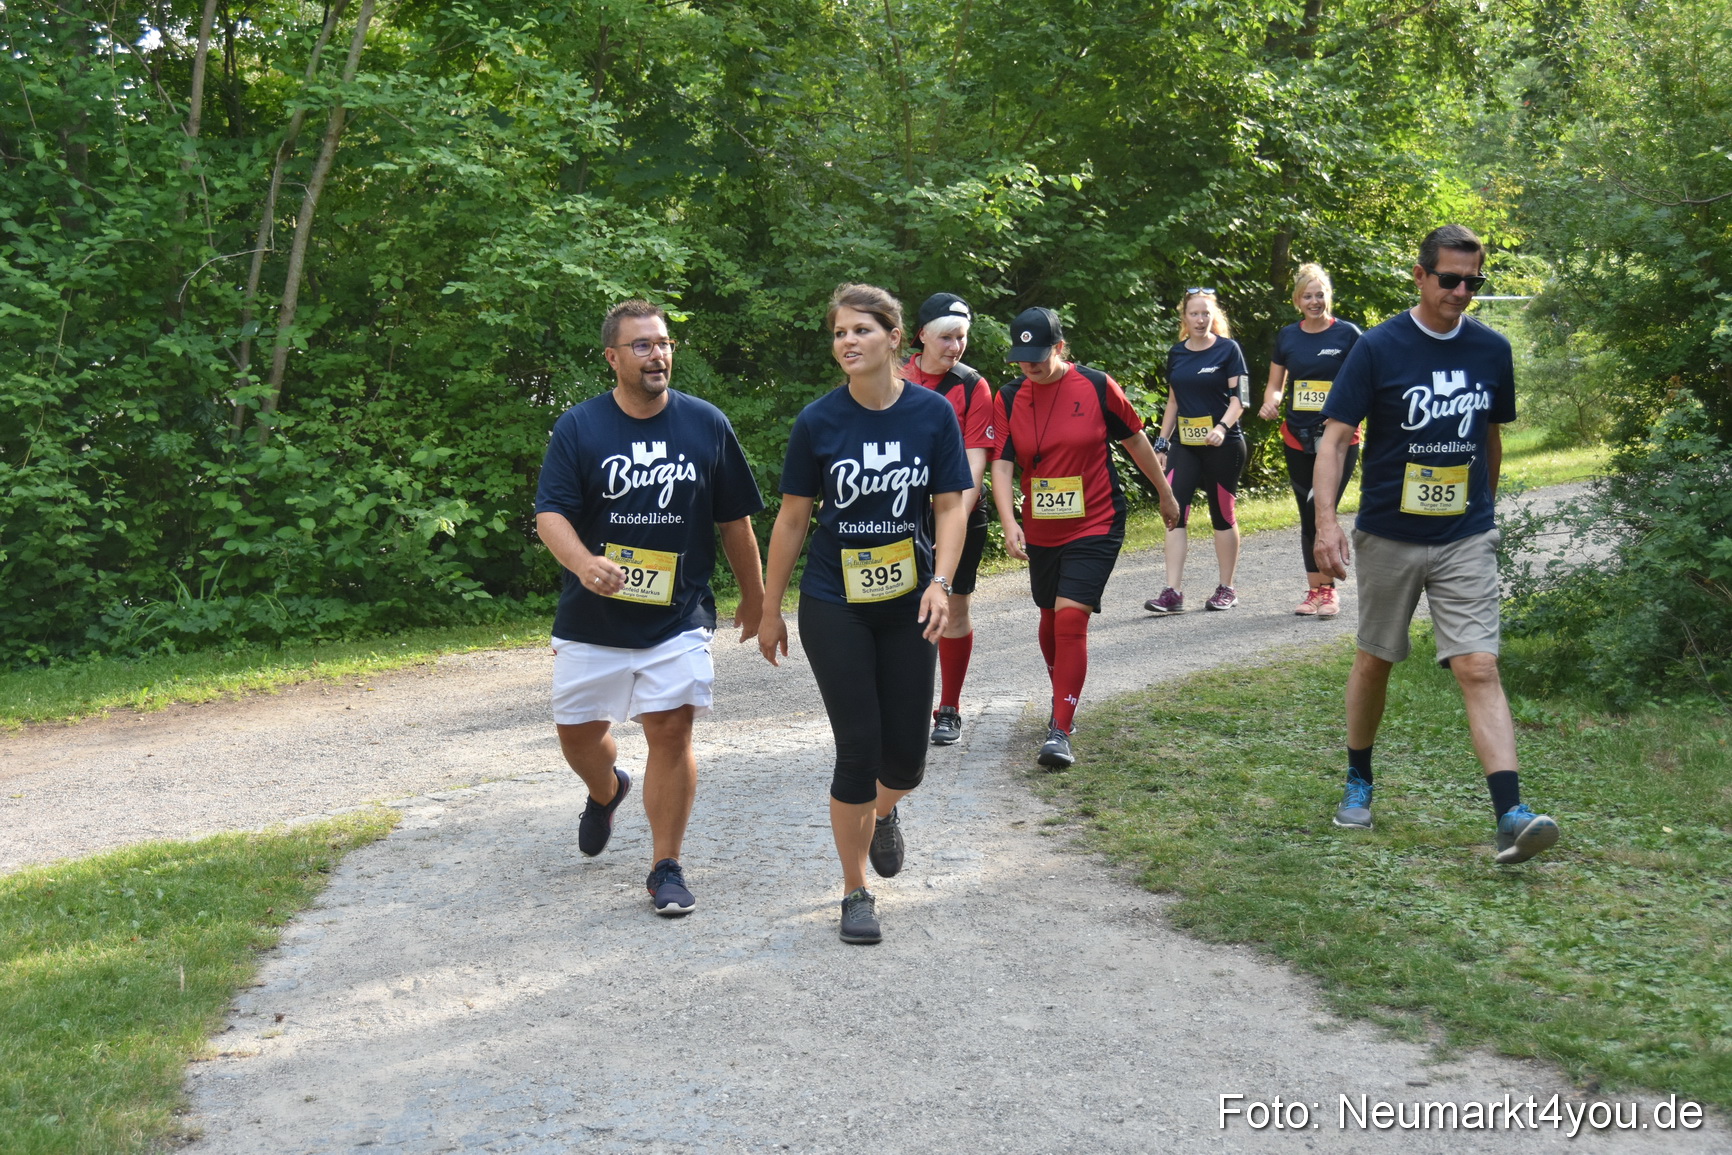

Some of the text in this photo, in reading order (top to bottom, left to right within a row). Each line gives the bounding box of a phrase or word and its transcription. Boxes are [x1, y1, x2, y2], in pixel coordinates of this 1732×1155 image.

[1297, 391, 1326, 403] 1439
[1400, 383, 1490, 438] Burgis
[1182, 426, 1208, 438] 1389
[601, 453, 697, 509] Burgis
[829, 456, 929, 518] Burgis
[1037, 492, 1075, 508] 2347
[1417, 484, 1455, 502] 385
[609, 512, 685, 525] Knödelliebe.
[861, 562, 902, 587] 395
[640, 588, 660, 596] Markus
[861, 582, 904, 594] Schmid Sandra
